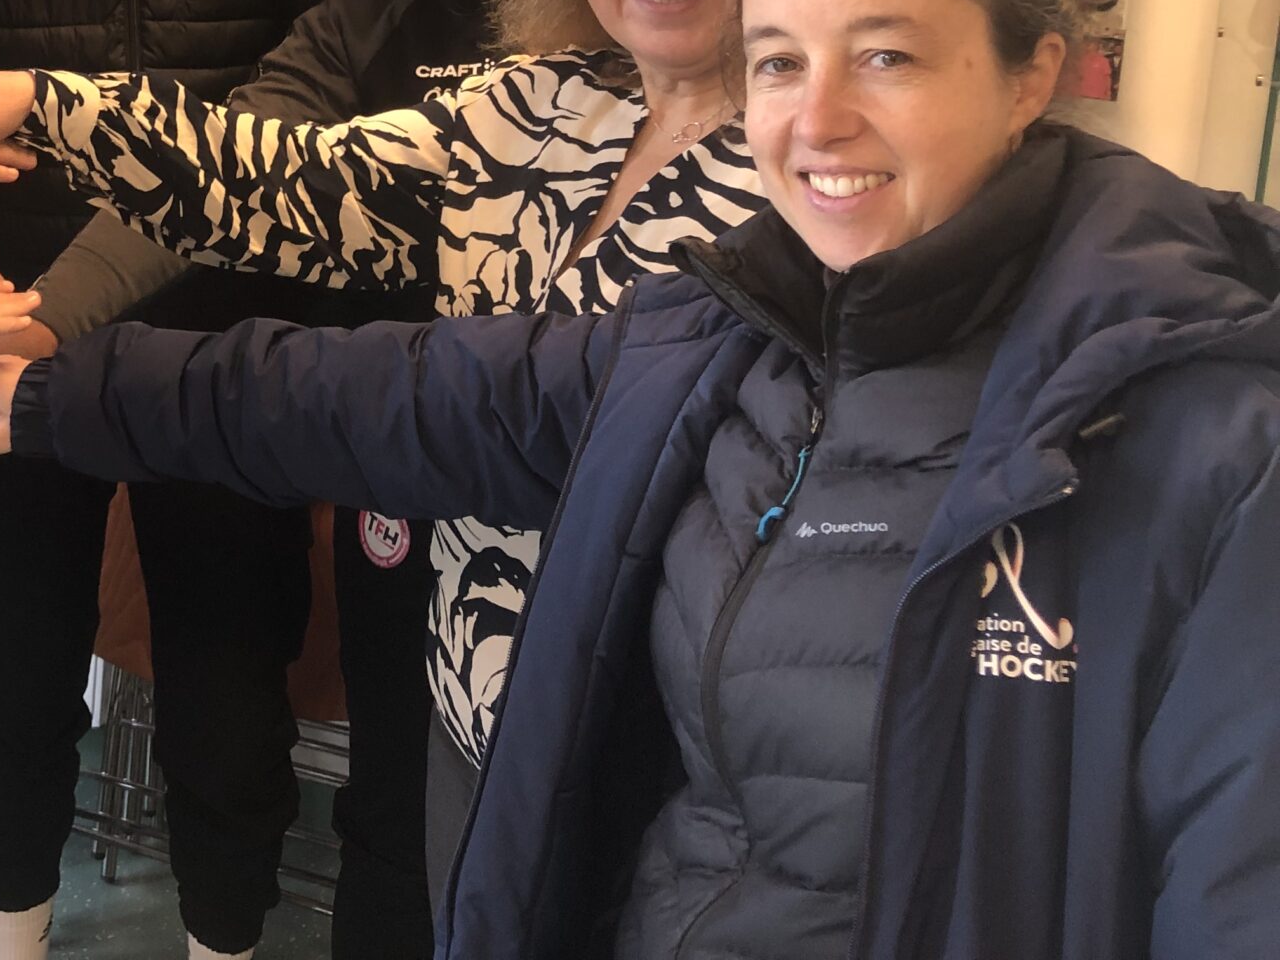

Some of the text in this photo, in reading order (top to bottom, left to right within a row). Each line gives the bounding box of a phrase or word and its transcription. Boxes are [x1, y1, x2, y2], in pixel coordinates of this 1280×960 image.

[415, 62, 482, 78] CRAFT
[368, 512, 400, 546] TFH
[820, 521, 889, 535] Quechua
[976, 612, 1025, 633] ation
[1016, 635, 1043, 656] de
